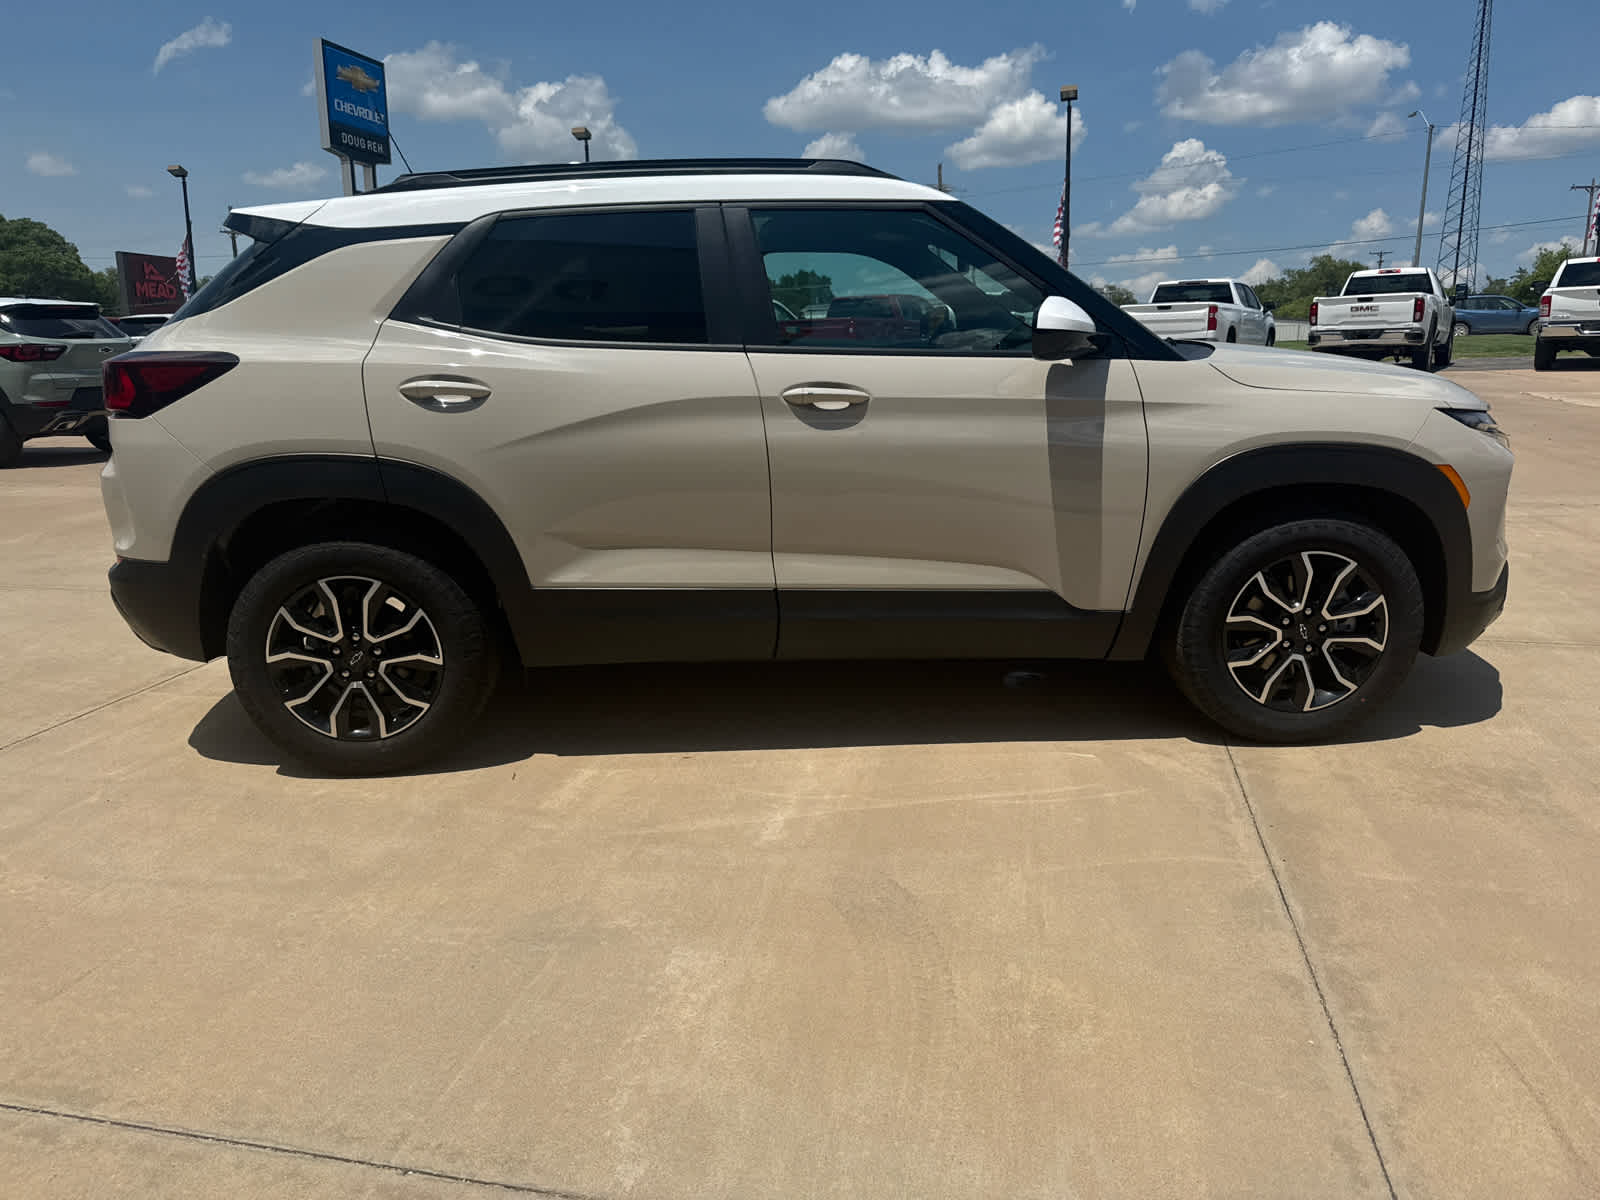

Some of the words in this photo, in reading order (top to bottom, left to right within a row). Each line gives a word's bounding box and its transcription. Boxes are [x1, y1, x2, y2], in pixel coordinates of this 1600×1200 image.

[334, 98, 385, 125] CHEVROLET
[341, 132, 366, 149] DOUG
[367, 140, 383, 152] REH
[135, 281, 177, 299] MEAD
